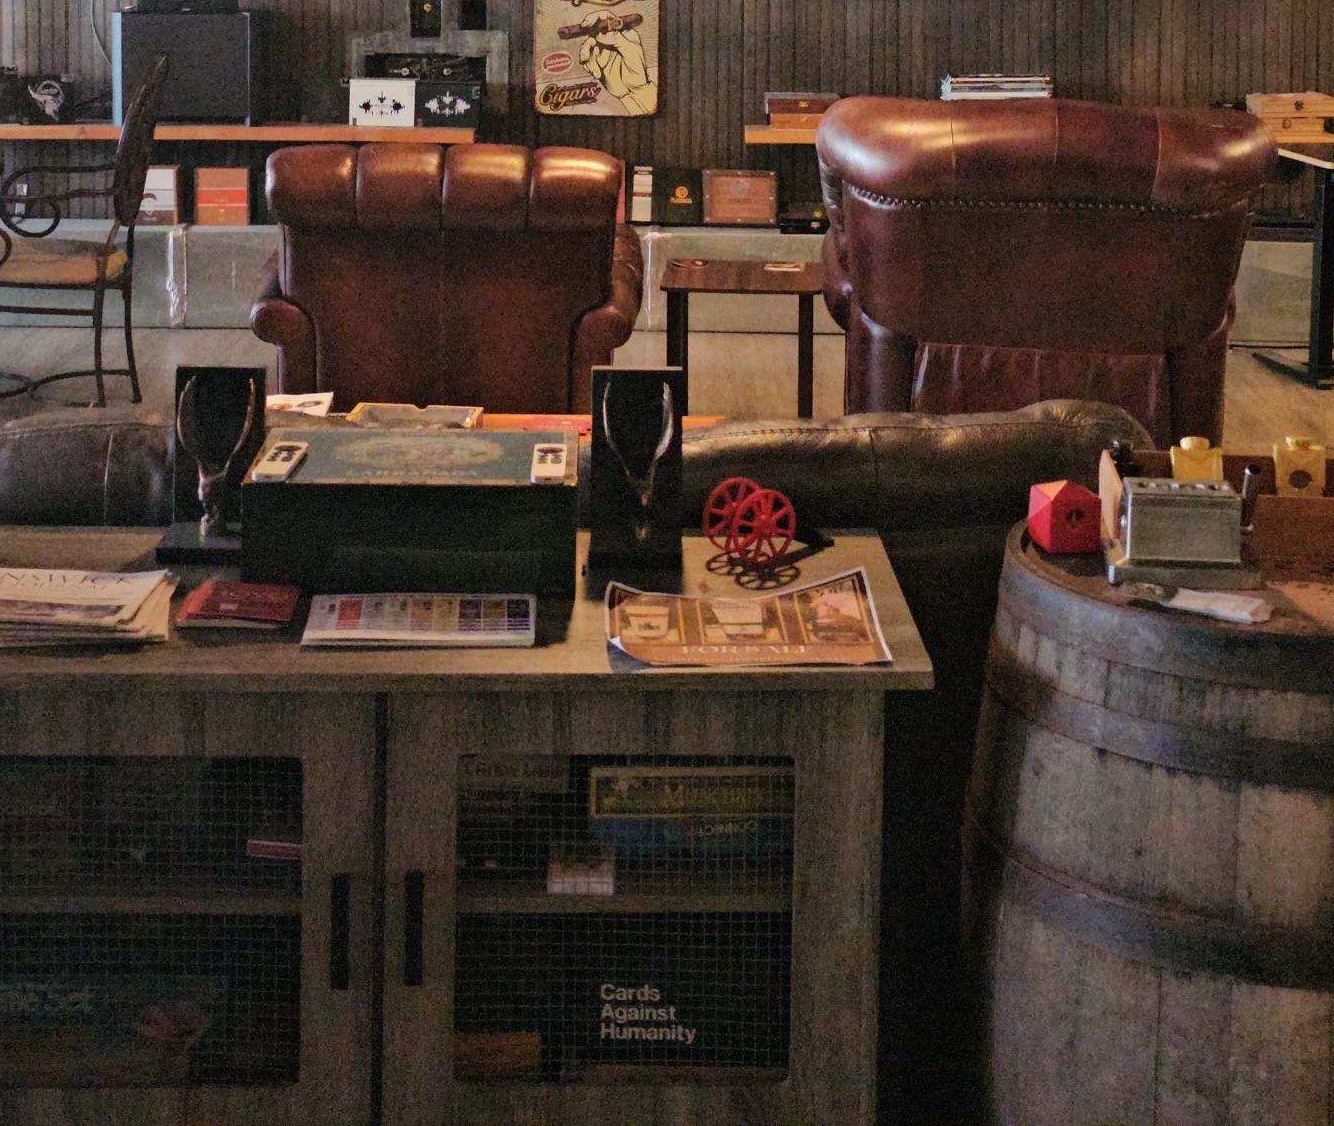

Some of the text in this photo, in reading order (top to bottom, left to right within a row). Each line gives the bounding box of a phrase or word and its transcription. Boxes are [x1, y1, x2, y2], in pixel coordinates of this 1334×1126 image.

[539, 83, 598, 111] Cigars
[599, 983, 661, 1002] Cards
[599, 1003, 677, 1023] Against
[599, 1023, 697, 1045] Humanity
